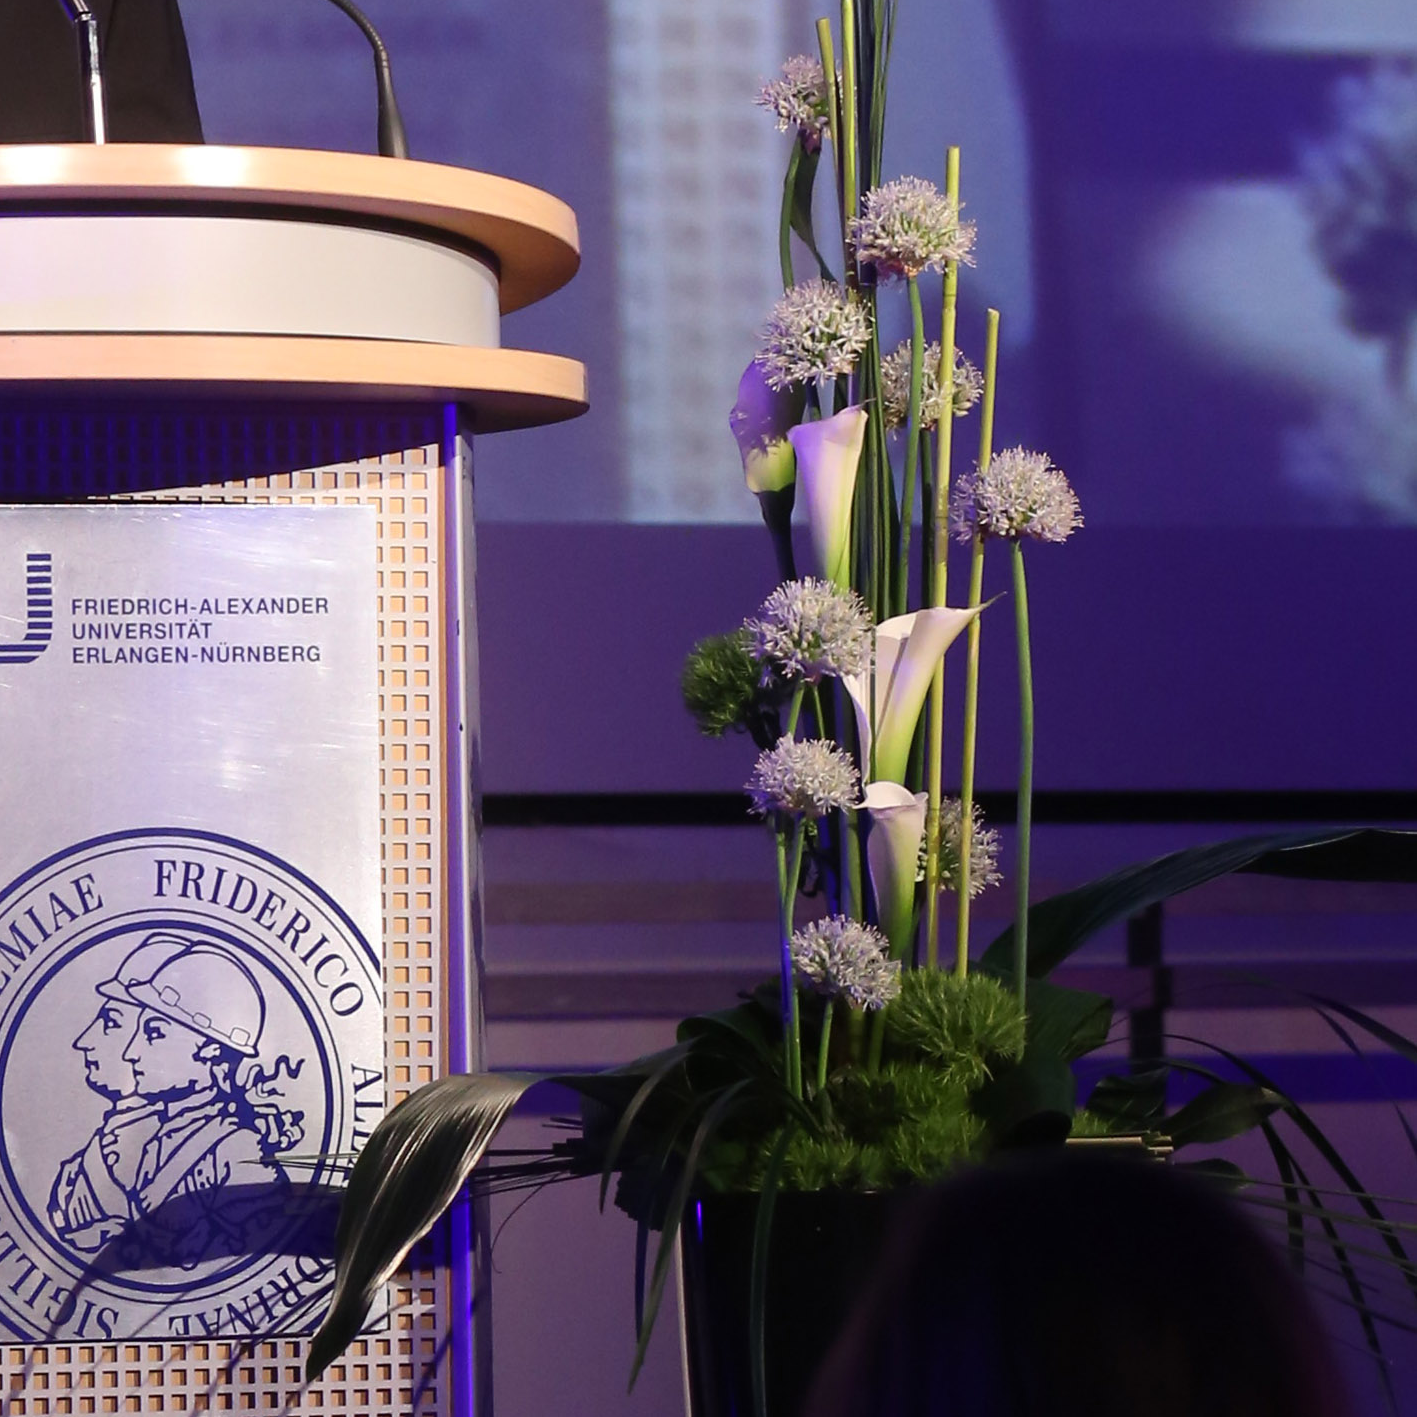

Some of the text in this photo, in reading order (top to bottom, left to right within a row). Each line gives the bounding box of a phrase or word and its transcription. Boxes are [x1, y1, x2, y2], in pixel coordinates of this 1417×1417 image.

[71, 597, 330, 616] FRIEDRICH-ALEXANDER
[72, 618, 213, 640] UNIVERSITÄT
[72, 641, 321, 664] ERLANGEN-NÜRNBERG
[152, 858, 365, 1018] FRIDERICO
